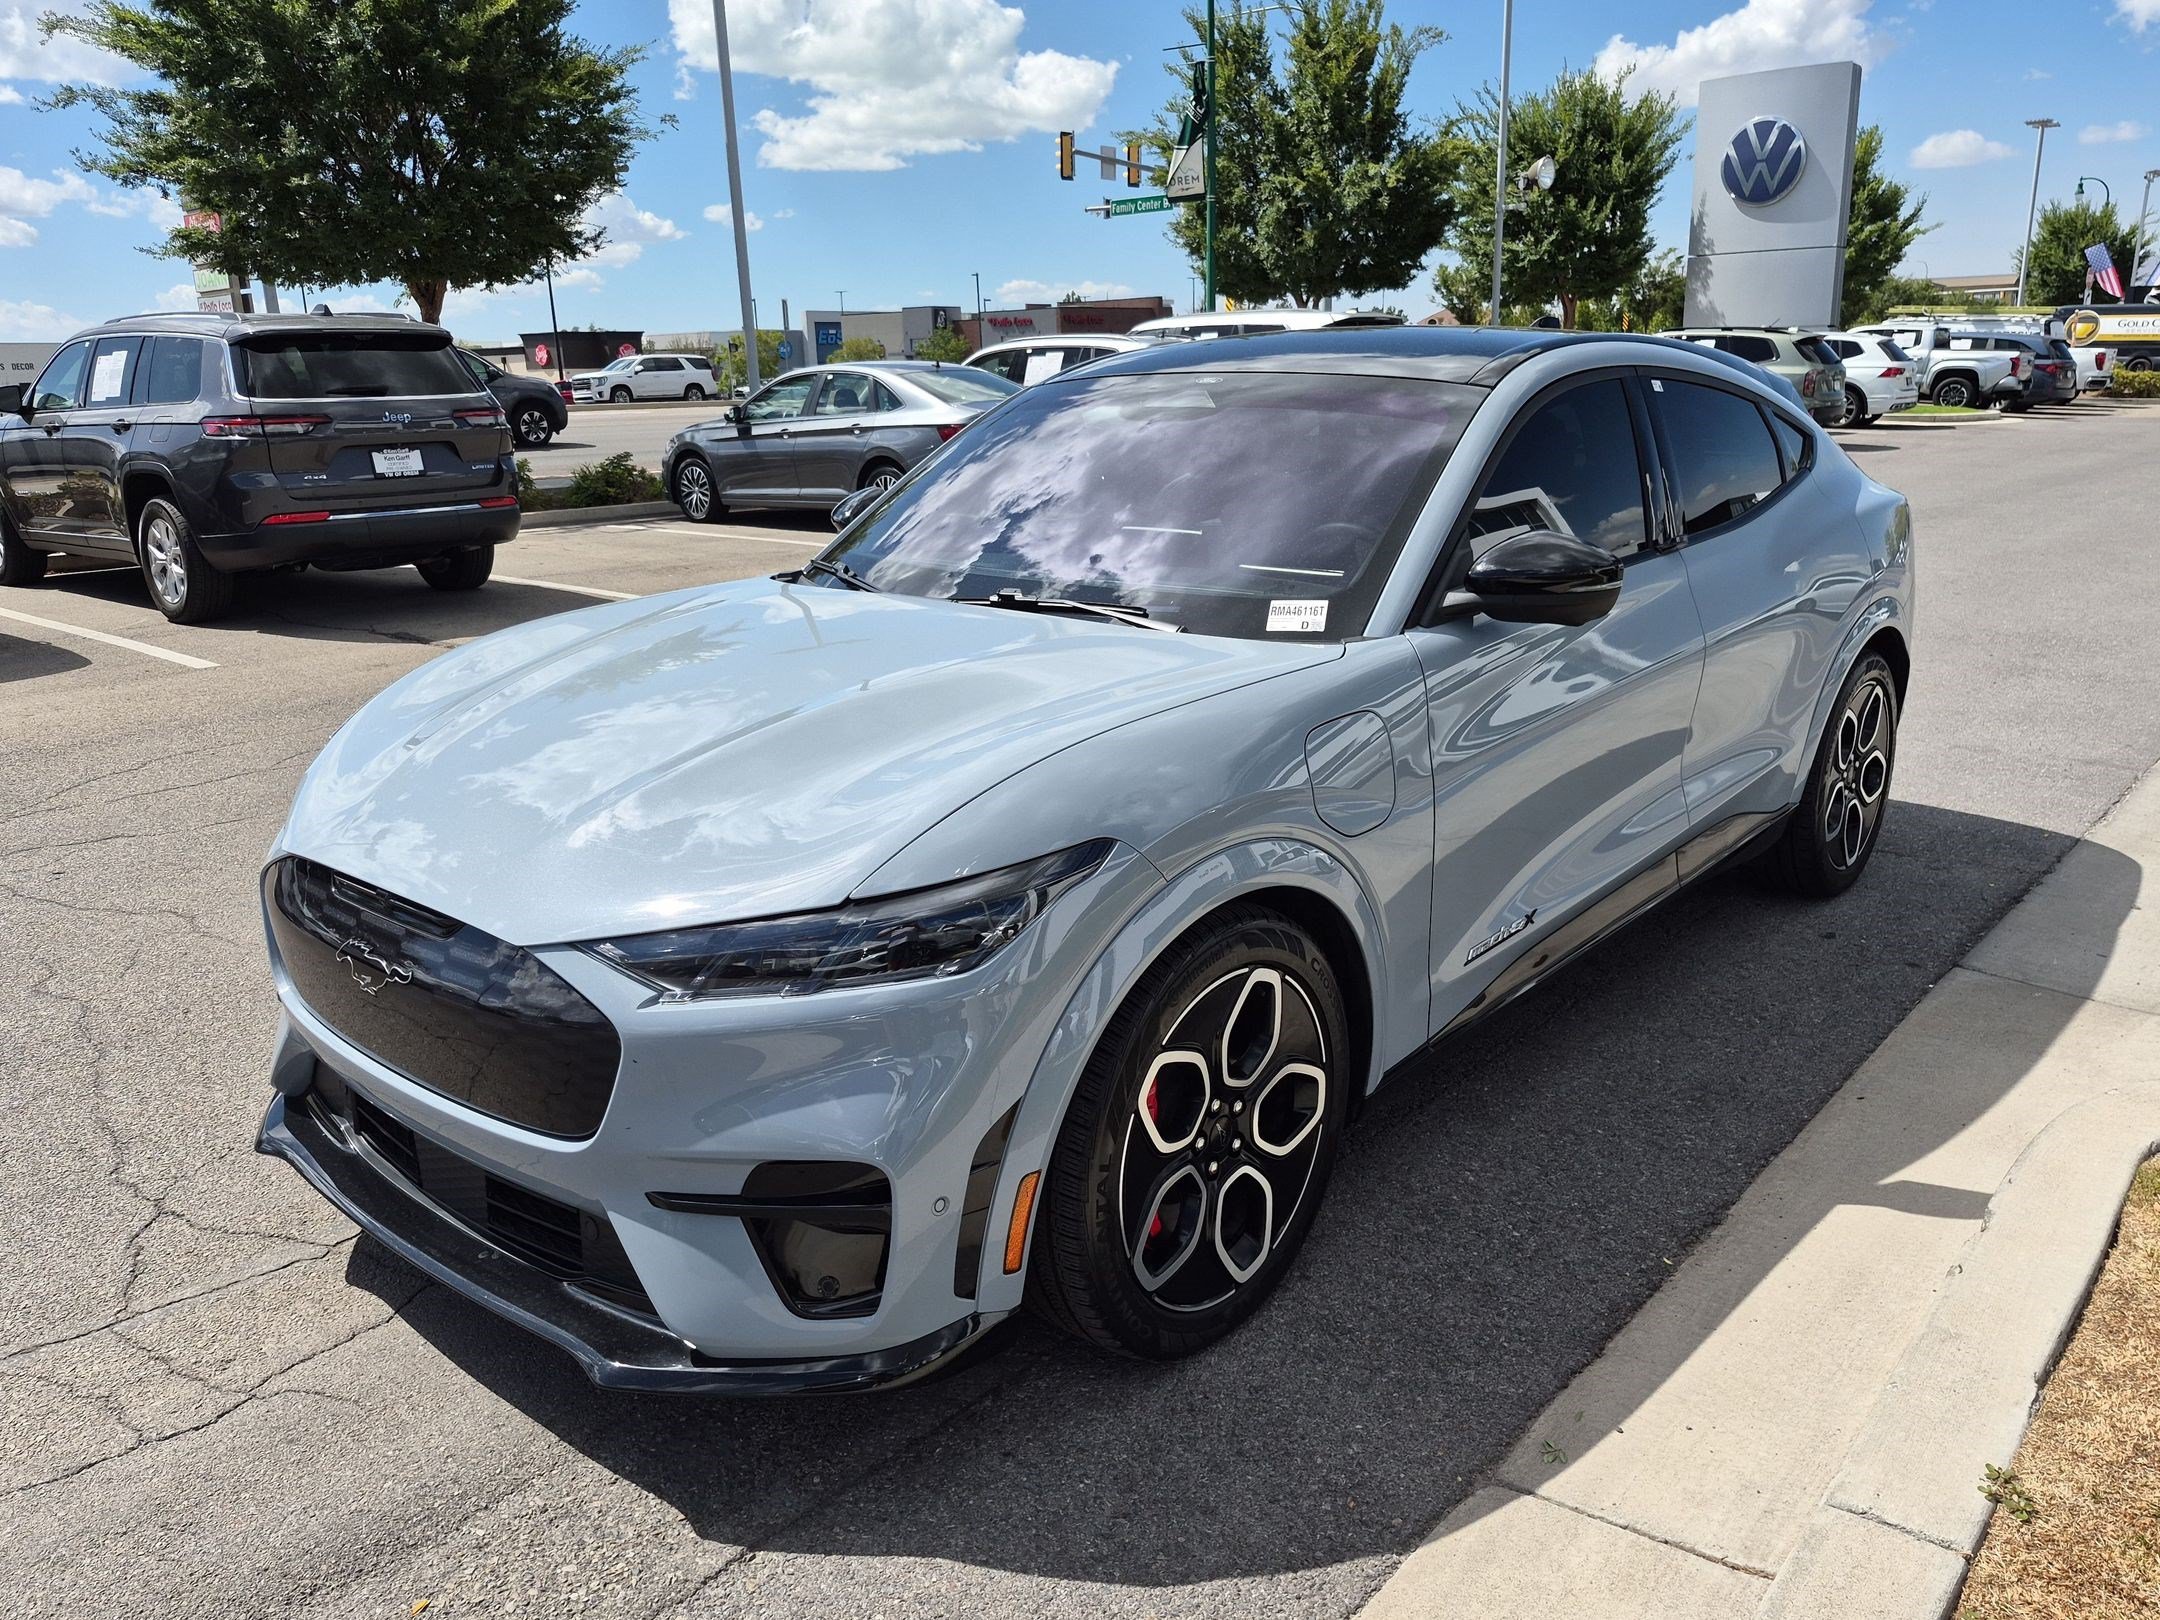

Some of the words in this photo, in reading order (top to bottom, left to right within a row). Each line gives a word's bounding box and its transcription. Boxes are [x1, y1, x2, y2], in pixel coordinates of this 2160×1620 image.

[1112, 202, 1136, 214] Family
[1137, 199, 1162, 211] Center
[2118, 319, 2149, 327] GOLD
[11, 363, 35, 371] DECOR
[382, 411, 412, 423] Jeep
[1270, 605, 1325, 616] RMA46116T
[1301, 620, 1309, 630] D
